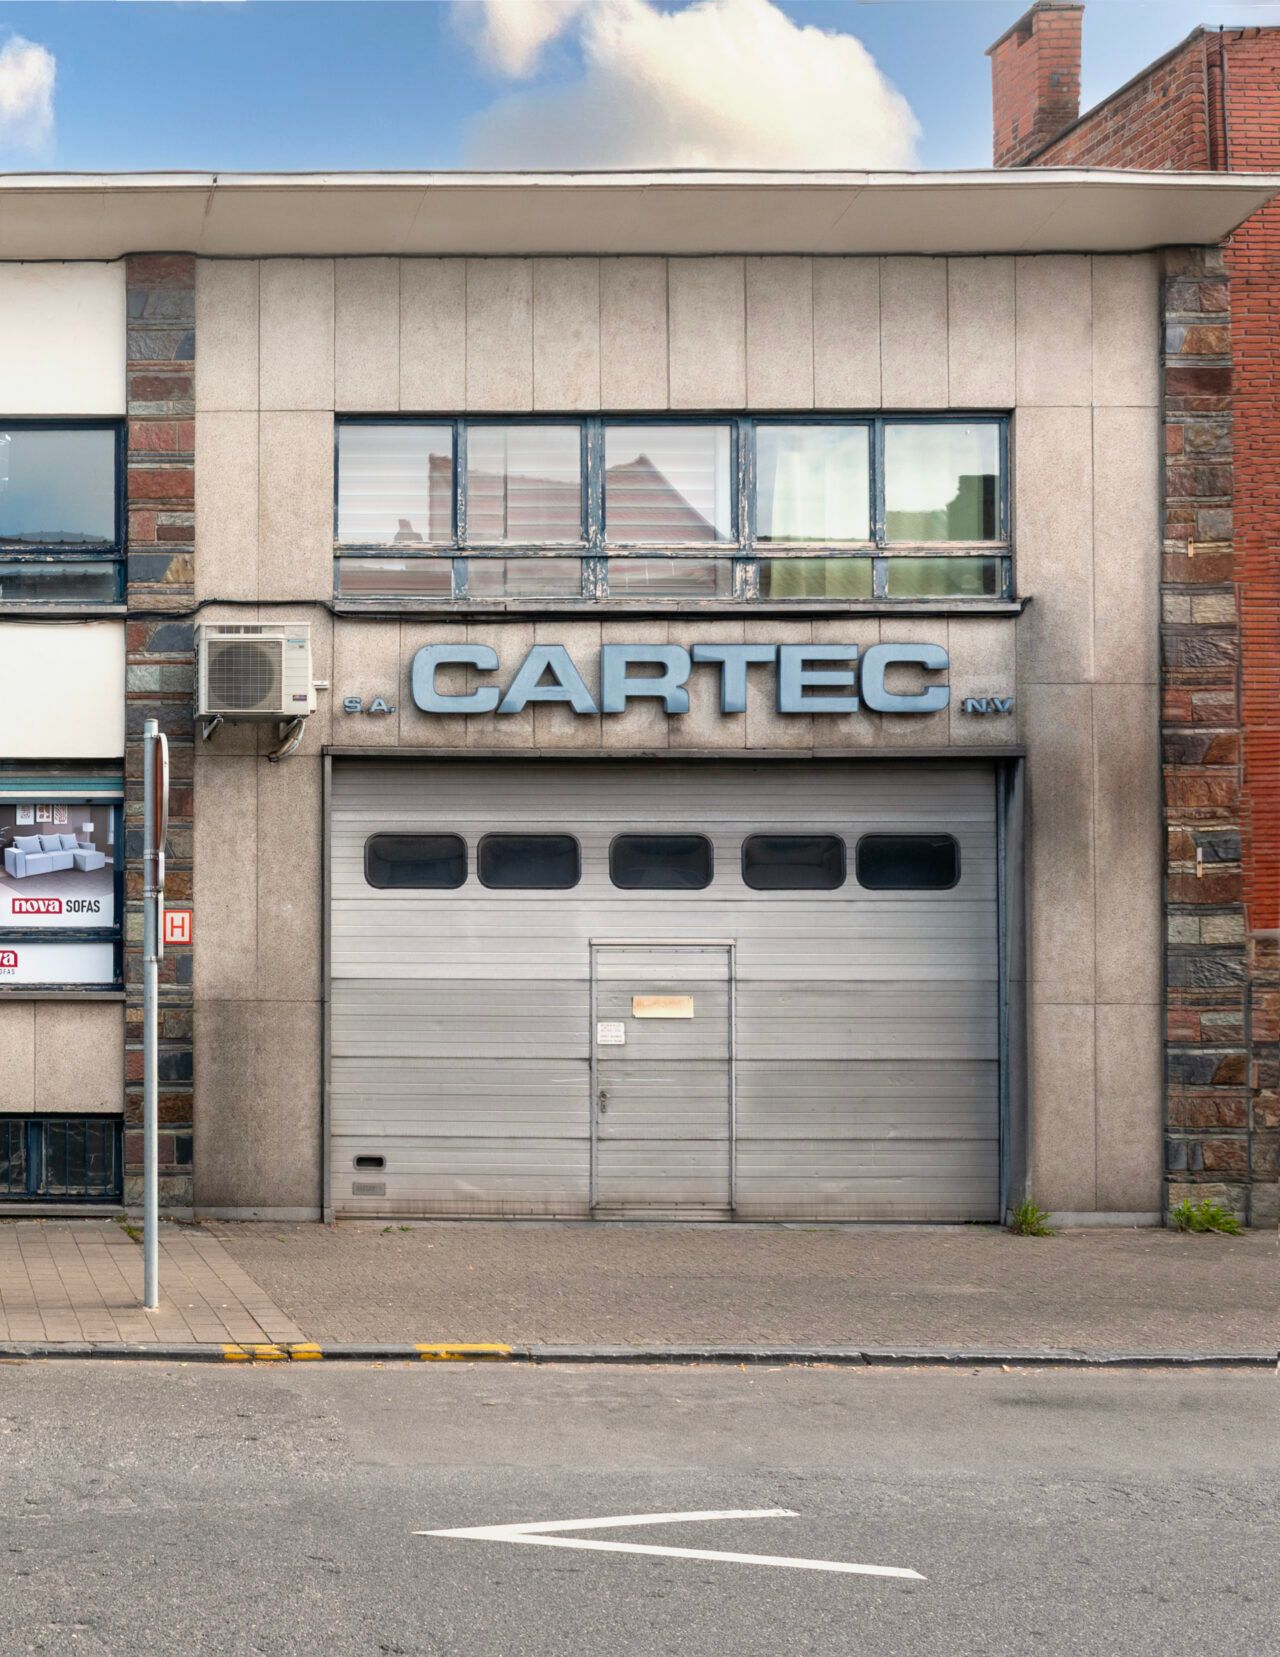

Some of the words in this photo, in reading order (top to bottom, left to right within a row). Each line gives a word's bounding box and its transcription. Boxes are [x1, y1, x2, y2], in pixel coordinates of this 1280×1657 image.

[411, 643, 950, 715] CARTEC
[14, 900, 61, 912] nova
[66, 900, 100, 913] SOFAS
[170, 916, 185, 938] H
